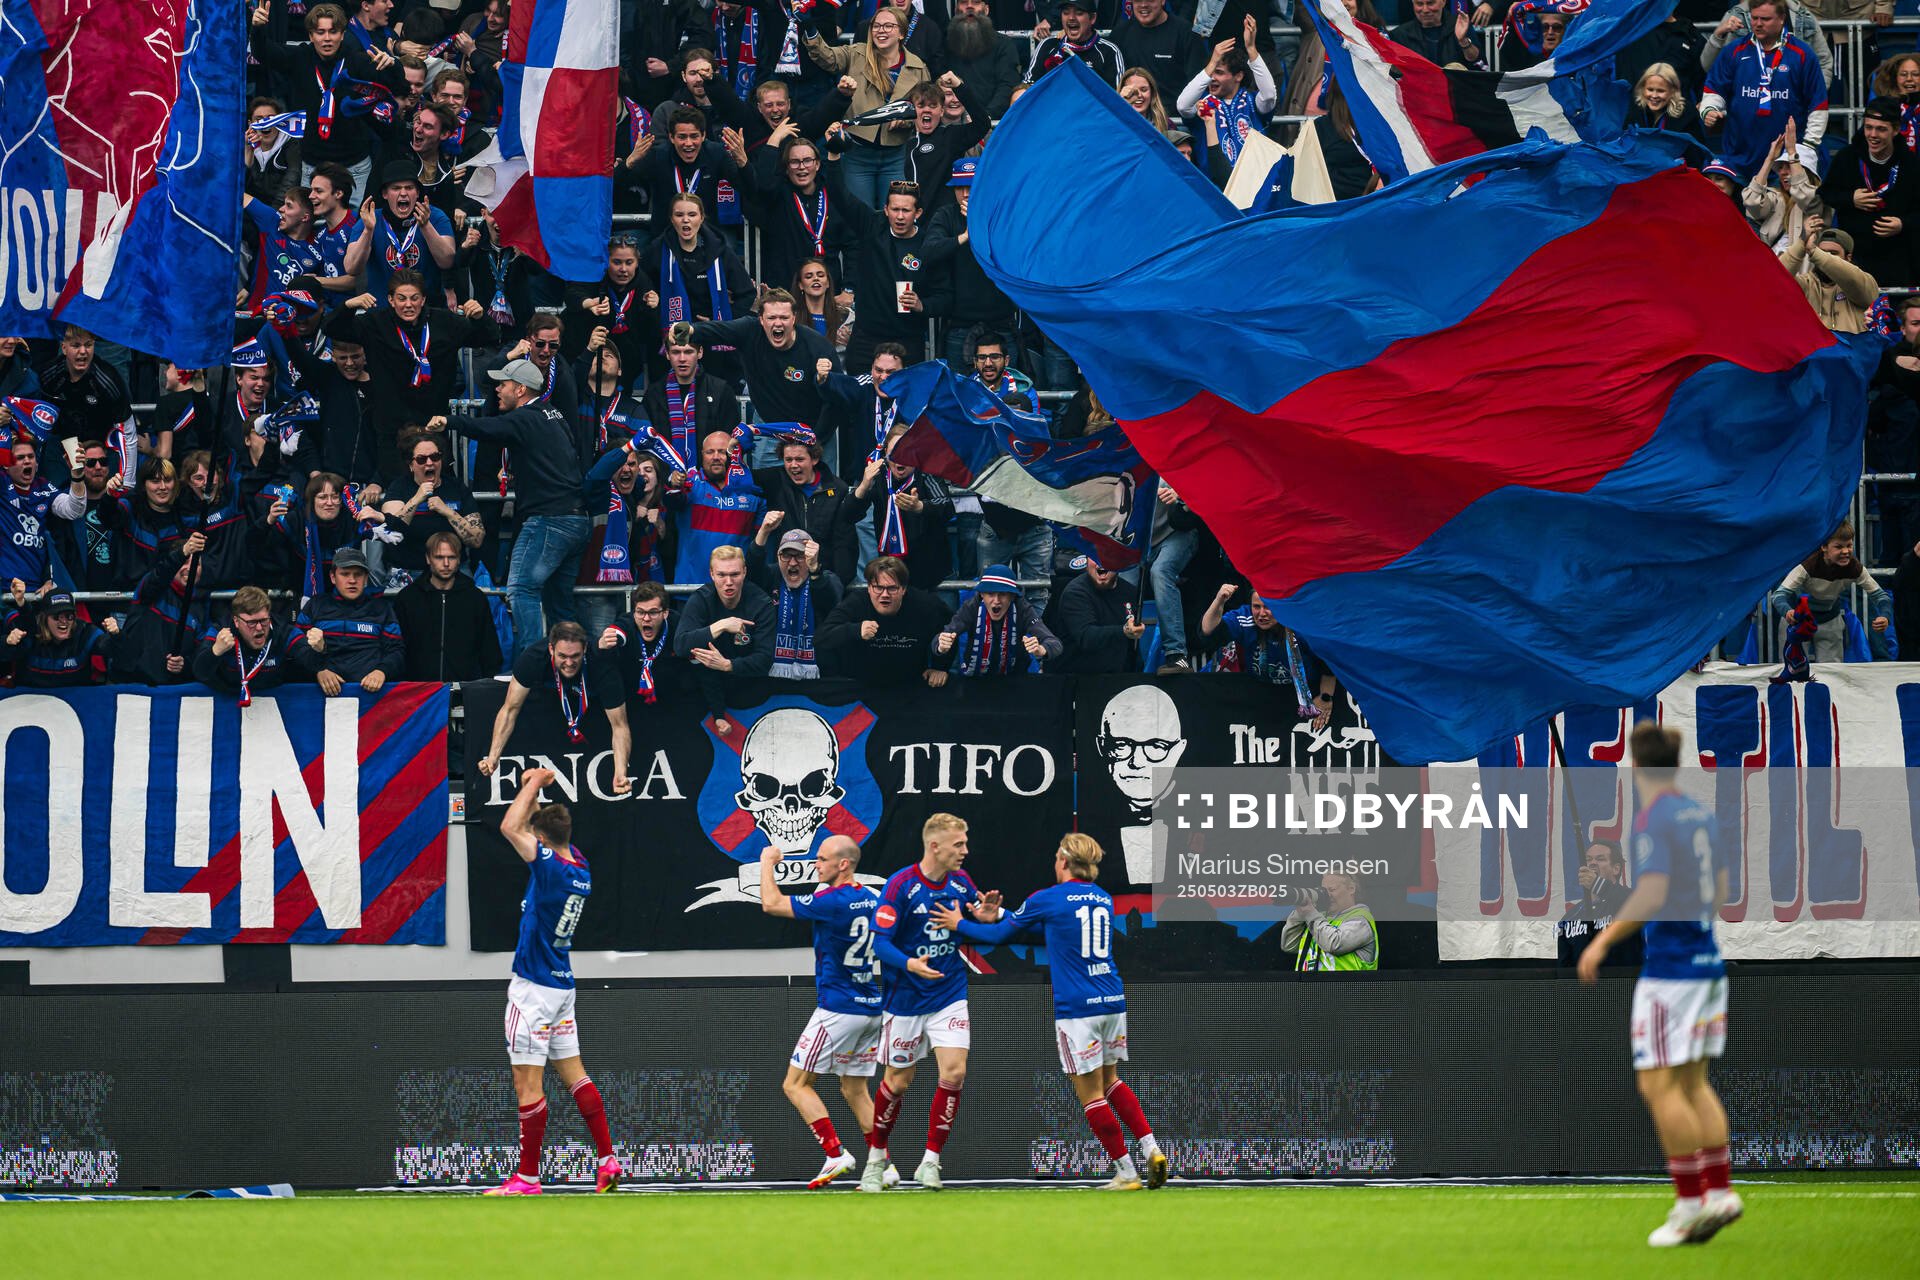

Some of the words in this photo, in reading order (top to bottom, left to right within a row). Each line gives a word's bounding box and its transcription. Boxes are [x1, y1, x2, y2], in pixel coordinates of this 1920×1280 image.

[1741, 85, 1789, 100] Hafund
[12, 532, 45, 550] OBOS
[1229, 724, 1281, 766] The
[889, 742, 1056, 797] TIFO
[1696, 681, 1869, 924] TIL
[774, 861, 818, 882] 997
[1075, 905, 1110, 959] 10
[916, 940, 956, 959] OBOS
